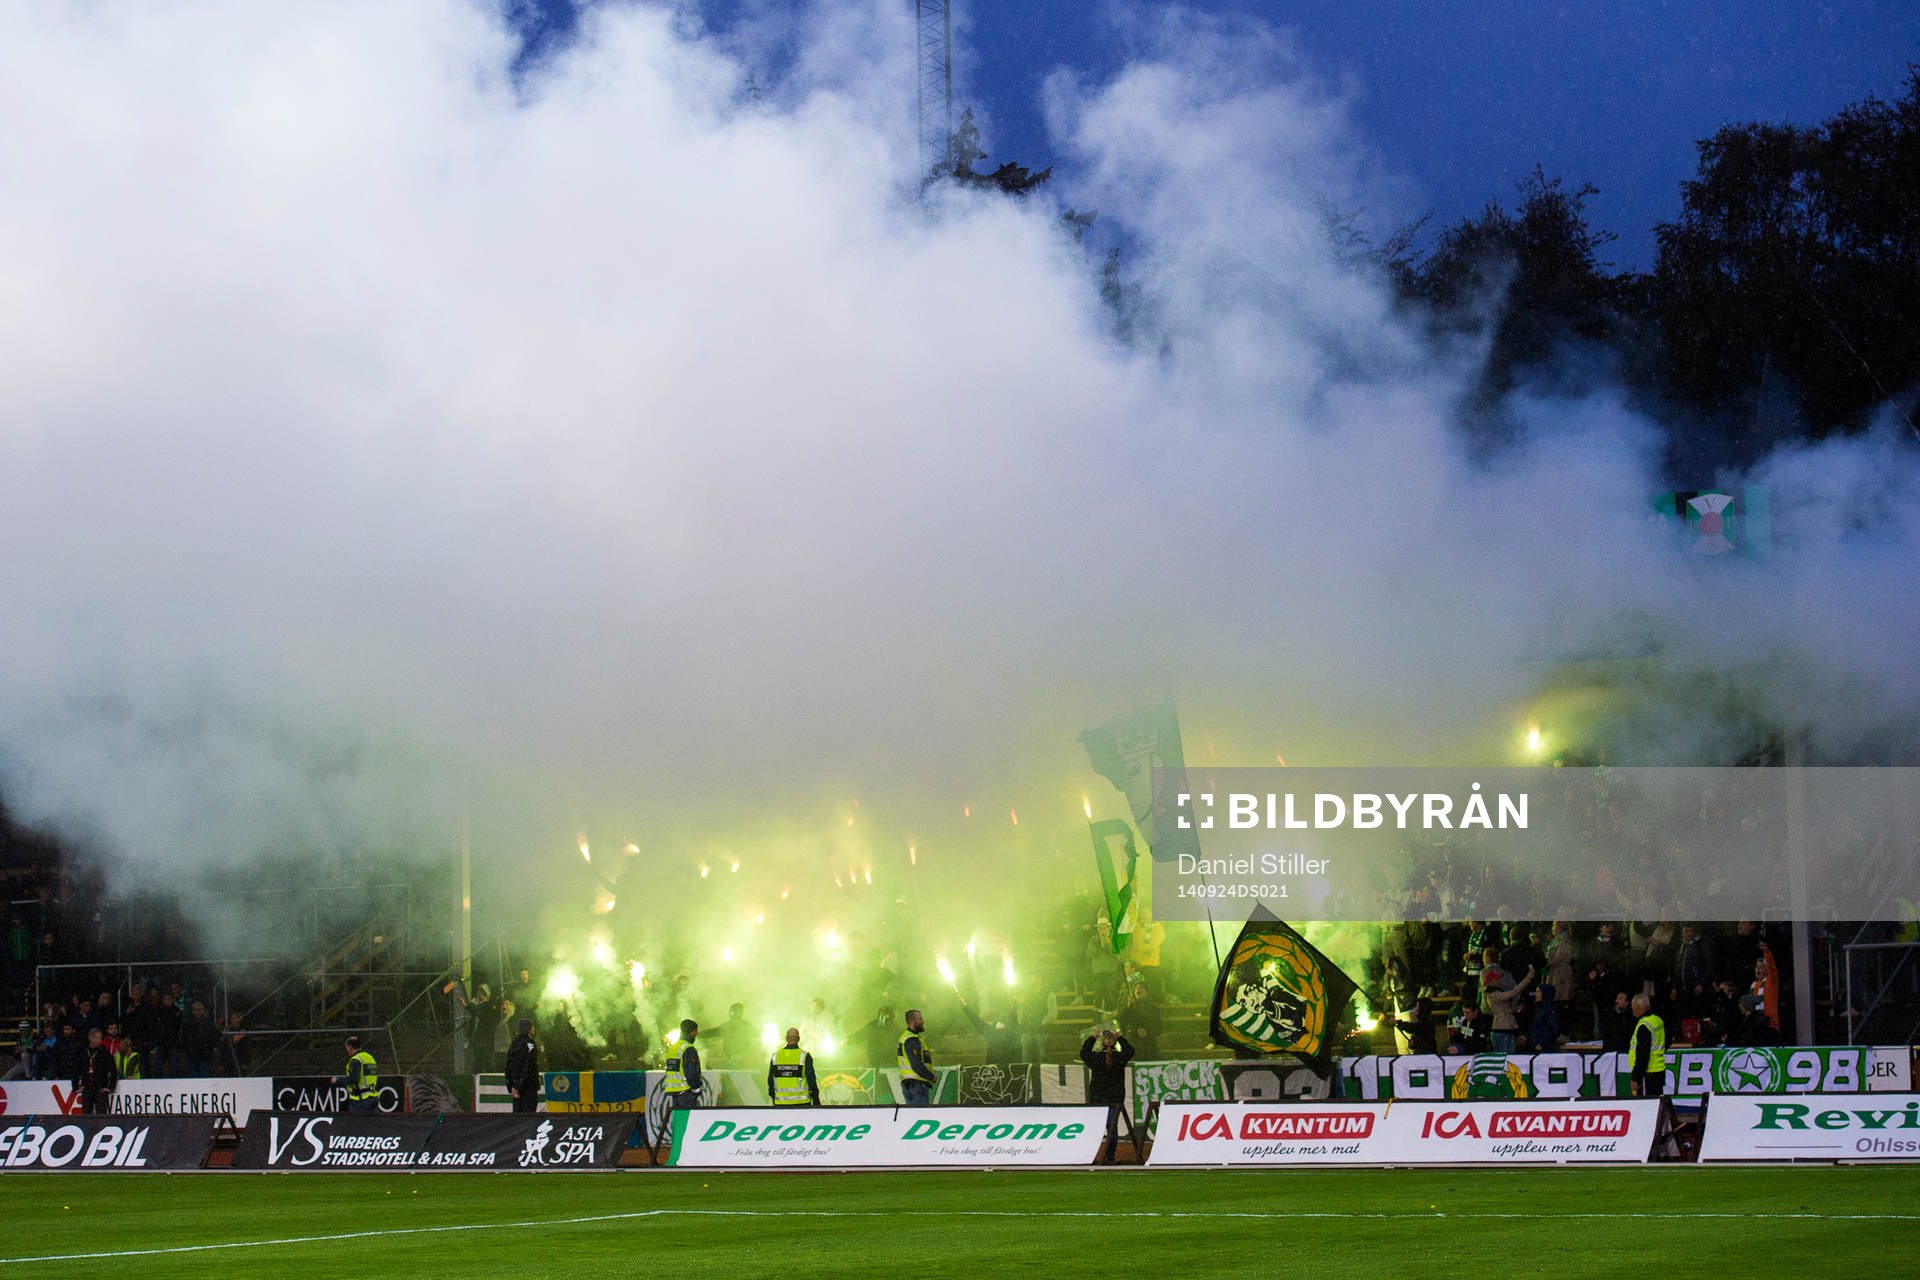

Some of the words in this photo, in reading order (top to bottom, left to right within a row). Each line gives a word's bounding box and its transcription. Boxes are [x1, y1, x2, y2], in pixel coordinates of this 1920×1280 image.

[1786, 1051, 1860, 1092] 98
[107, 1094, 173, 1114] VARBERG
[181, 1093, 236, 1114] ENERGI
[559, 1126, 604, 1142] ASIA
[700, 1121, 872, 1142] Derome
[901, 1120, 1085, 1141] Derome
[1178, 1113, 1233, 1141] ICA
[1247, 1117, 1367, 1135] KVANTUM
[1422, 1111, 1481, 1139] ICA
[1496, 1115, 1622, 1132] KVANTUM
[80, 1125, 150, 1167] BIL
[267, 1116, 333, 1166] VS
[329, 1135, 402, 1150] VARBERGS
[1242, 1143, 1295, 1158] upplev
[1298, 1146, 1327, 1155] mer
[1331, 1143, 1360, 1155] mat
[1491, 1141, 1547, 1157] upplev
[1551, 1144, 1581, 1154] mer
[1586, 1141, 1617, 1153] mat
[1856, 1137, 1920, 1153] Ohlss
[321, 1151, 416, 1166] STADSHOTELL
[417, 1152, 431, 1165] &
[431, 1152, 466, 1166] ASIA
[467, 1151, 496, 1165] SPA
[549, 1142, 595, 1164] SPA
